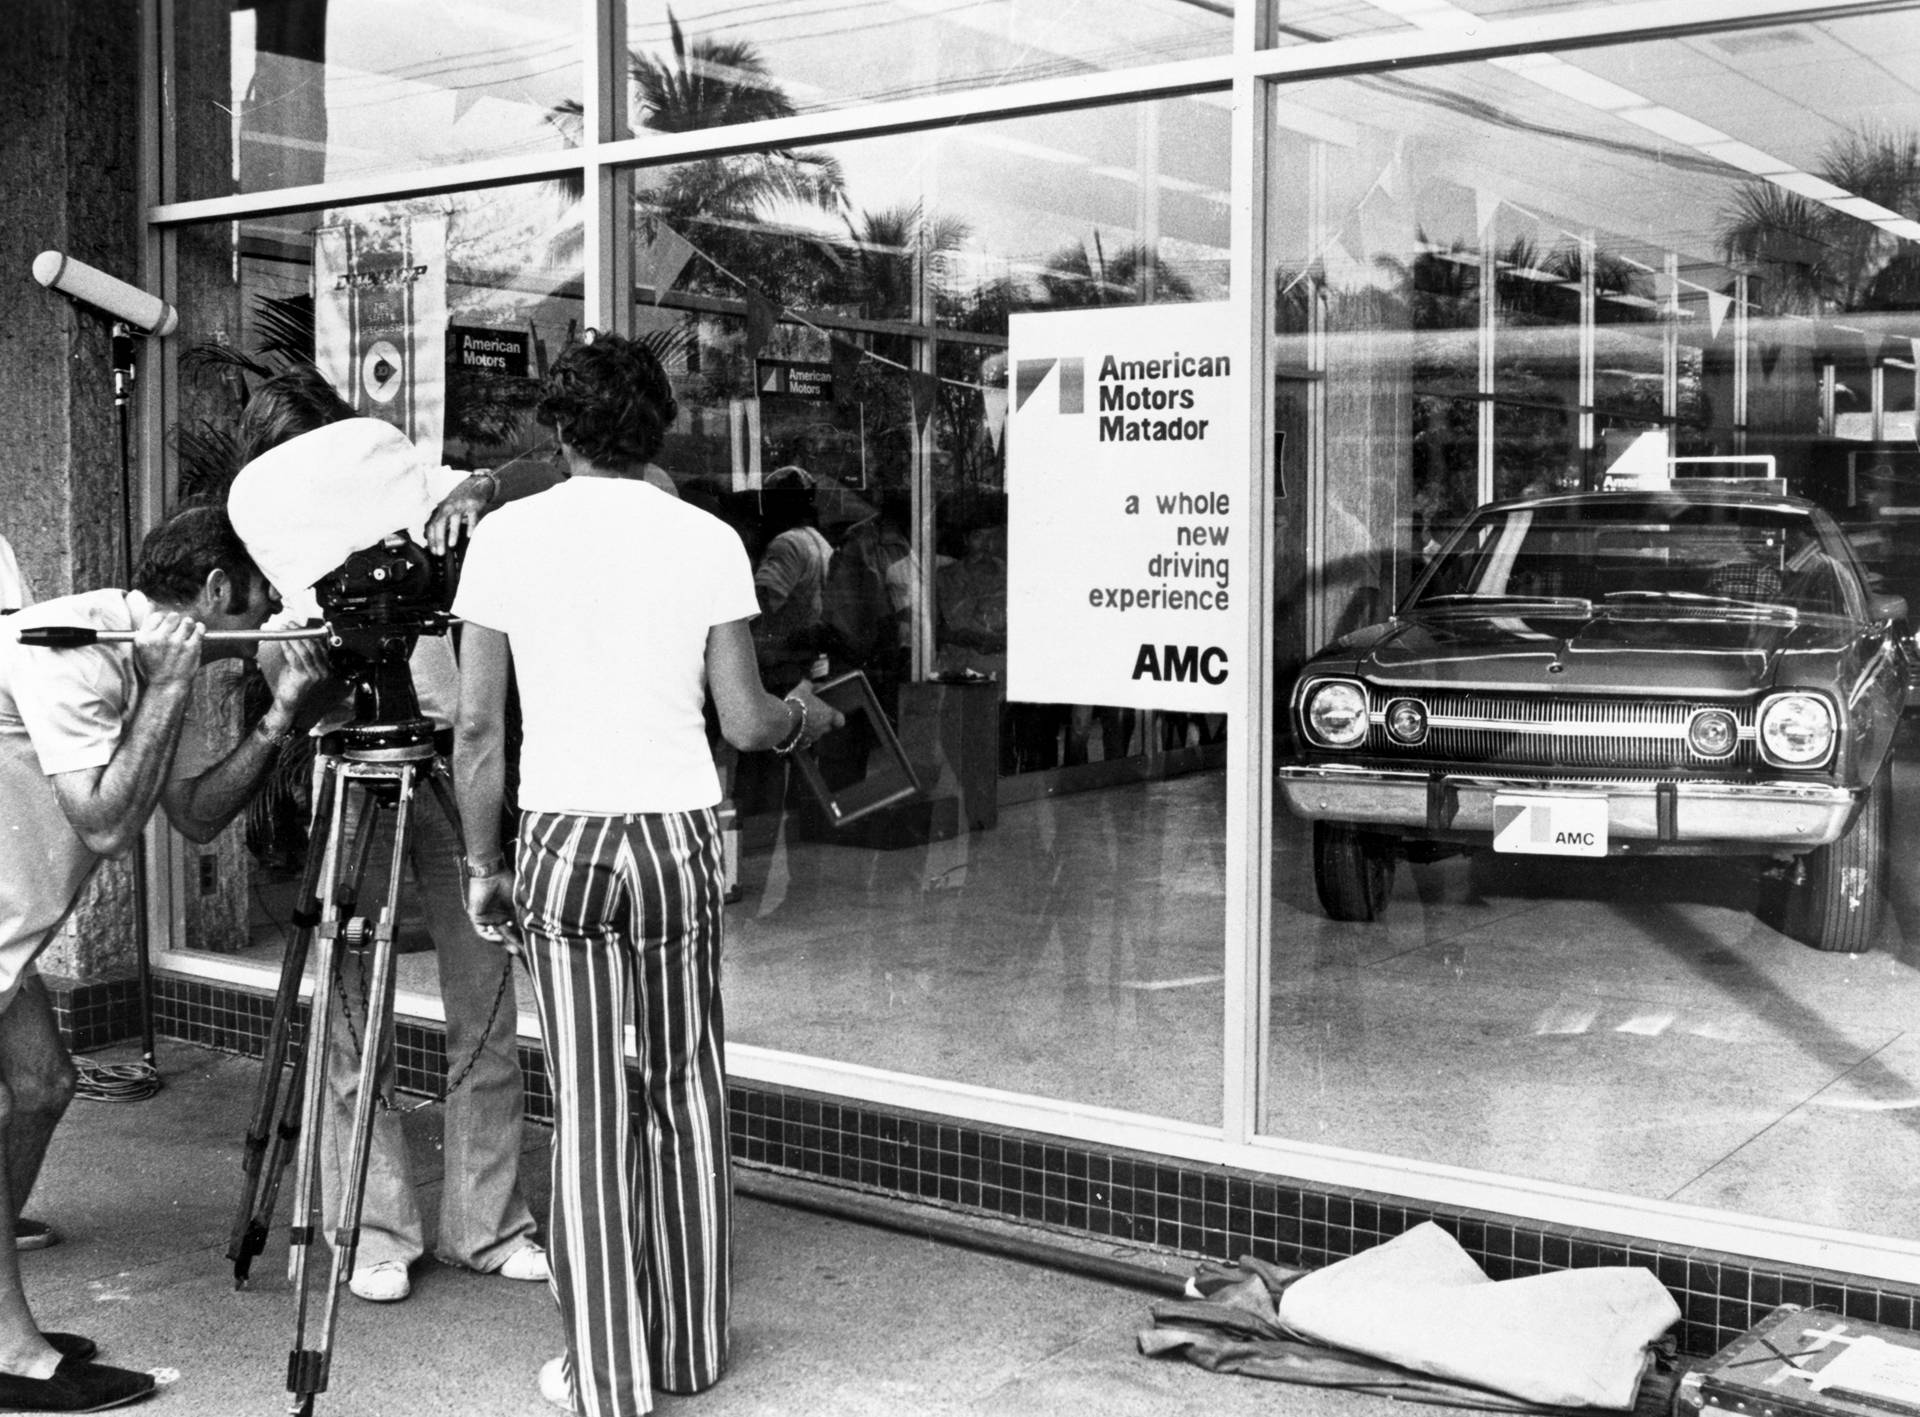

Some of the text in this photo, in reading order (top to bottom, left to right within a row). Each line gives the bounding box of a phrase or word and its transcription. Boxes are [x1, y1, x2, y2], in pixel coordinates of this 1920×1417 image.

[463, 335, 521, 353] American
[463, 350, 506, 368] Motors
[1098, 352, 1231, 382] American
[788, 367, 832, 382] American
[789, 380, 821, 395] Motors
[1099, 385, 1195, 411] Motors
[1099, 416, 1209, 442] Matador
[1124, 491, 1230, 515] a whole
[1177, 526, 1230, 546] new
[1148, 551, 1230, 590] driving
[1089, 583, 1229, 612] experience
[1131, 643, 1229, 686] AMC
[1555, 831, 1595, 846] AMC
